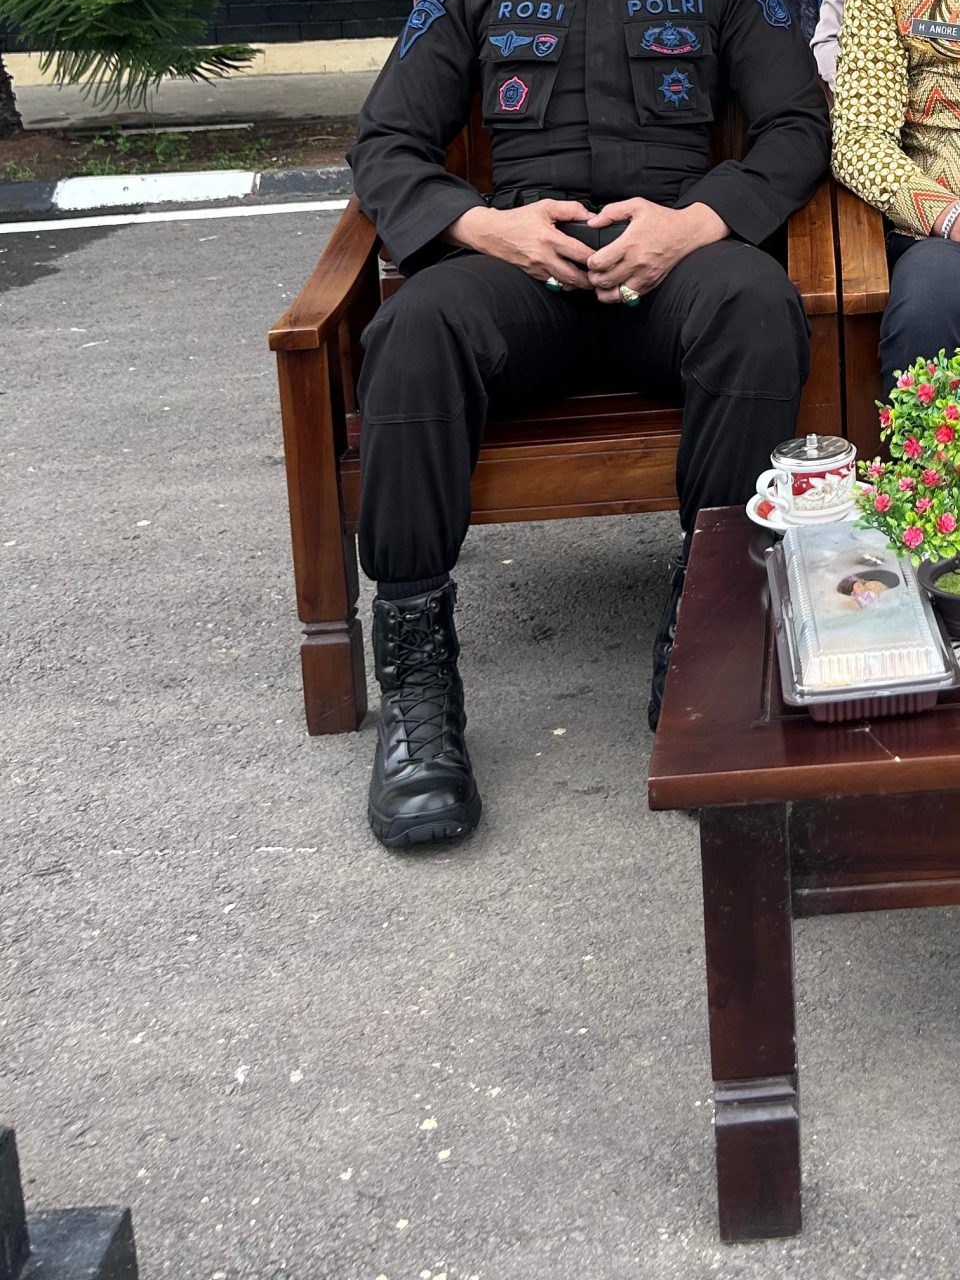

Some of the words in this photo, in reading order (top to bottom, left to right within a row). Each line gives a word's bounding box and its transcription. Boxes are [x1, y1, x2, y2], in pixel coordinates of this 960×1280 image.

[498, 1, 565, 20] ROBI
[918, 23, 925, 32] H
[929, 24, 958, 36] ANDRE
